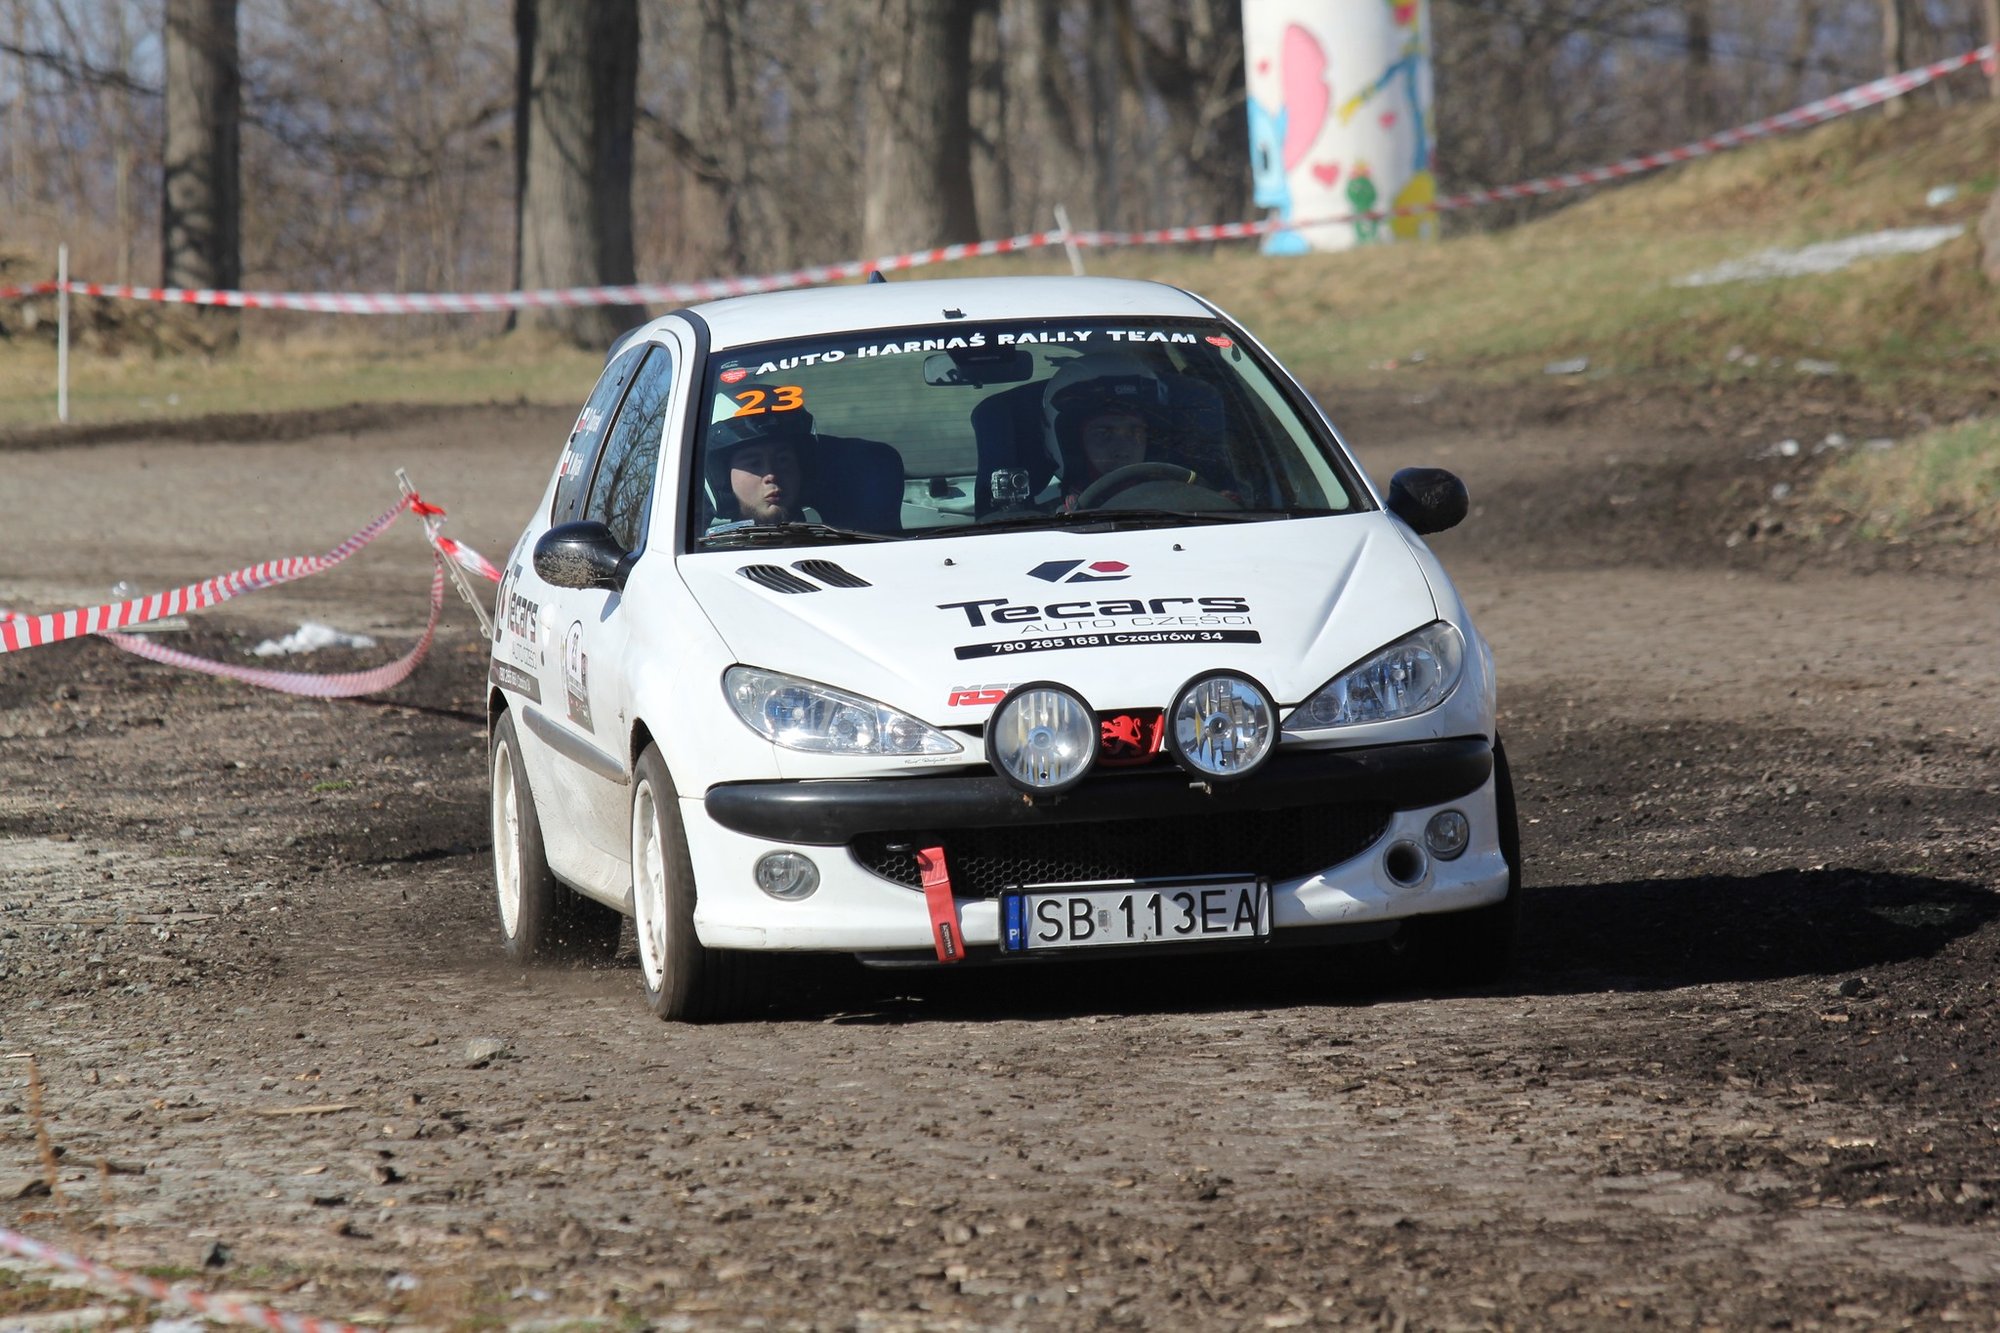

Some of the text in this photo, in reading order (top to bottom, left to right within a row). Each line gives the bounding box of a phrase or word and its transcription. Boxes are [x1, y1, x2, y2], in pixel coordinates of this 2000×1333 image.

[755, 350, 845, 375] AUTO
[857, 333, 986, 358] HARNAŚ
[997, 330, 1093, 345] RALLY
[1106, 330, 1198, 345] TEAM
[734, 385, 804, 417] 23
[936, 597, 1251, 628] Tecars
[1021, 614, 1254, 635] AUTO CZĘŚCI
[992, 632, 1224, 654] 790 265 168 Czadrów 34
[947, 683, 1020, 707] MS
[1036, 889, 1256, 942] SB 113EA
